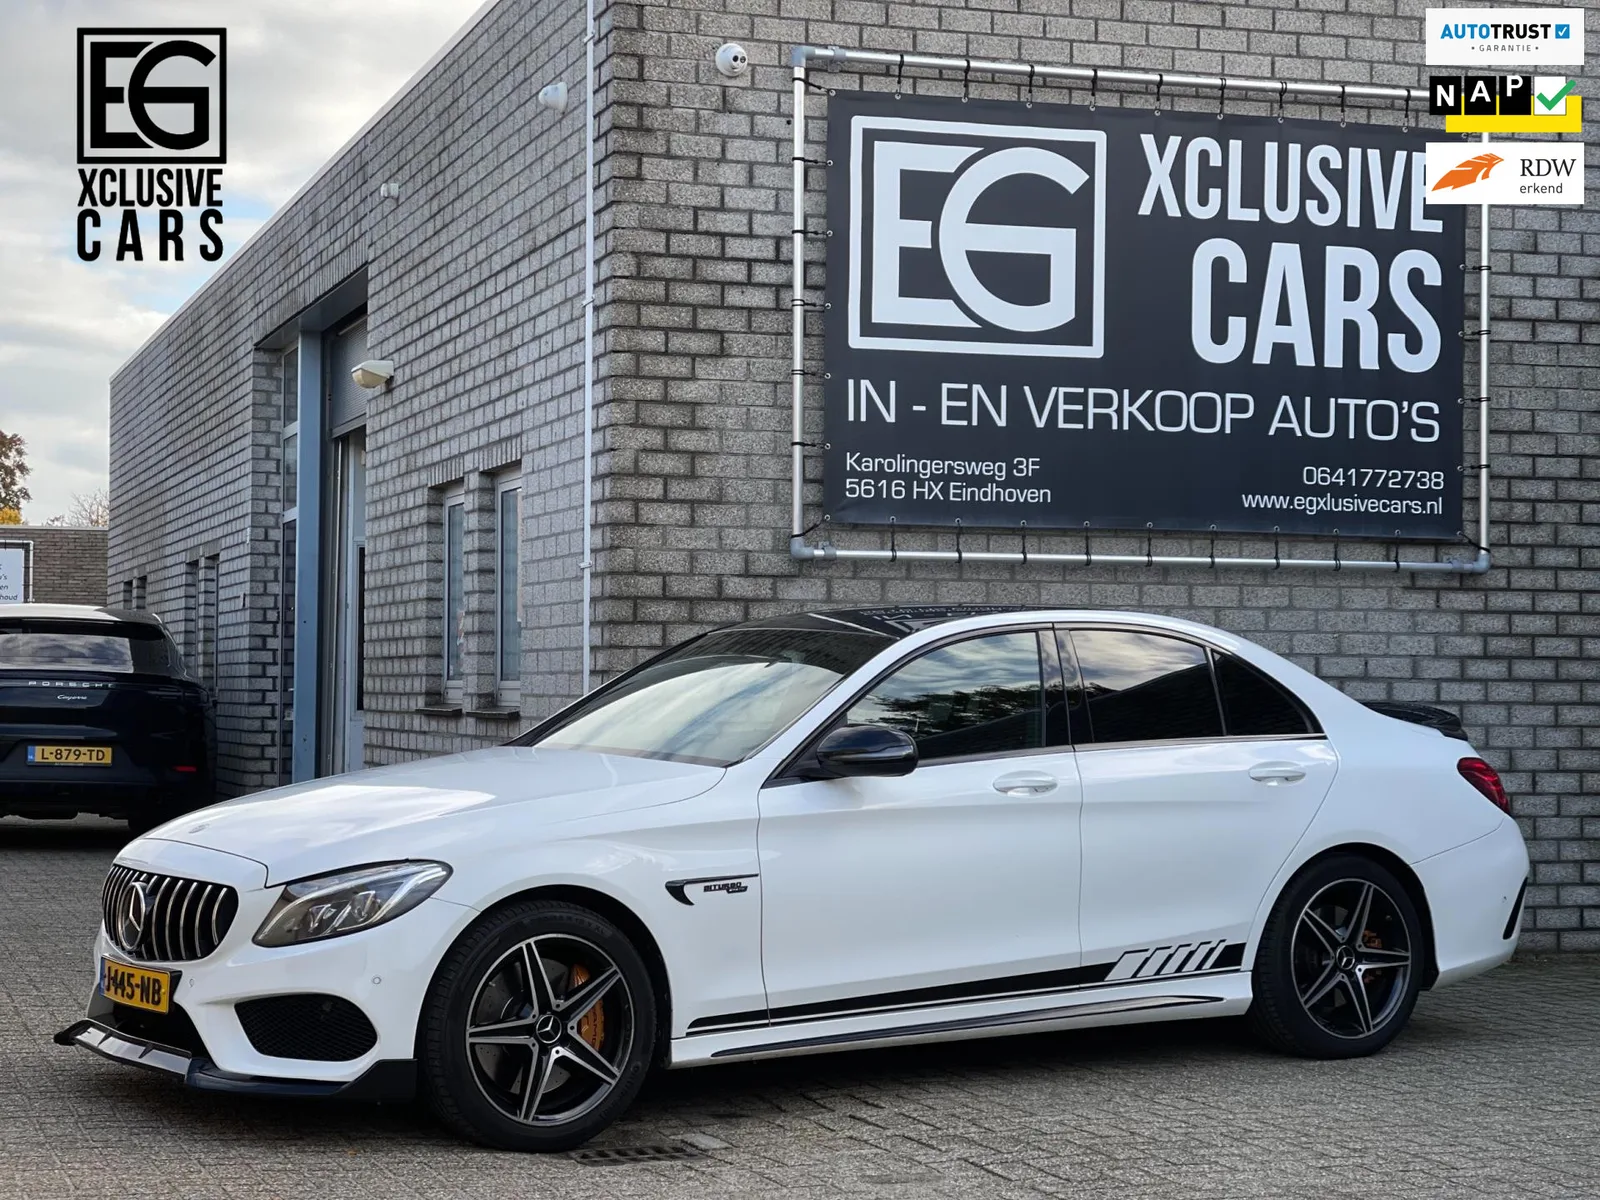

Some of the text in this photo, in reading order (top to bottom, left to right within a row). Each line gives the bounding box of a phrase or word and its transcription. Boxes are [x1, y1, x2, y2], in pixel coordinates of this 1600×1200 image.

[1137, 133, 1444, 233] XCLUSIVE
[871, 140, 1090, 332] EG
[1191, 237, 1443, 373] CARS
[847, 379, 896, 423] IN
[941, 382, 1007, 427] EN
[1023, 385, 1255, 434] VERKOOP
[1268, 395, 1440, 443] AUTO'S
[846, 452, 1041, 480] Karolingersweg 3F
[1303, 466, 1445, 490] 0641772738
[845, 479, 1051, 503] 5616 HX Eindhoven
[1242, 493, 1443, 515] www.egxlusivecars.nl
[41, 748, 105, 761] L-879-TD
